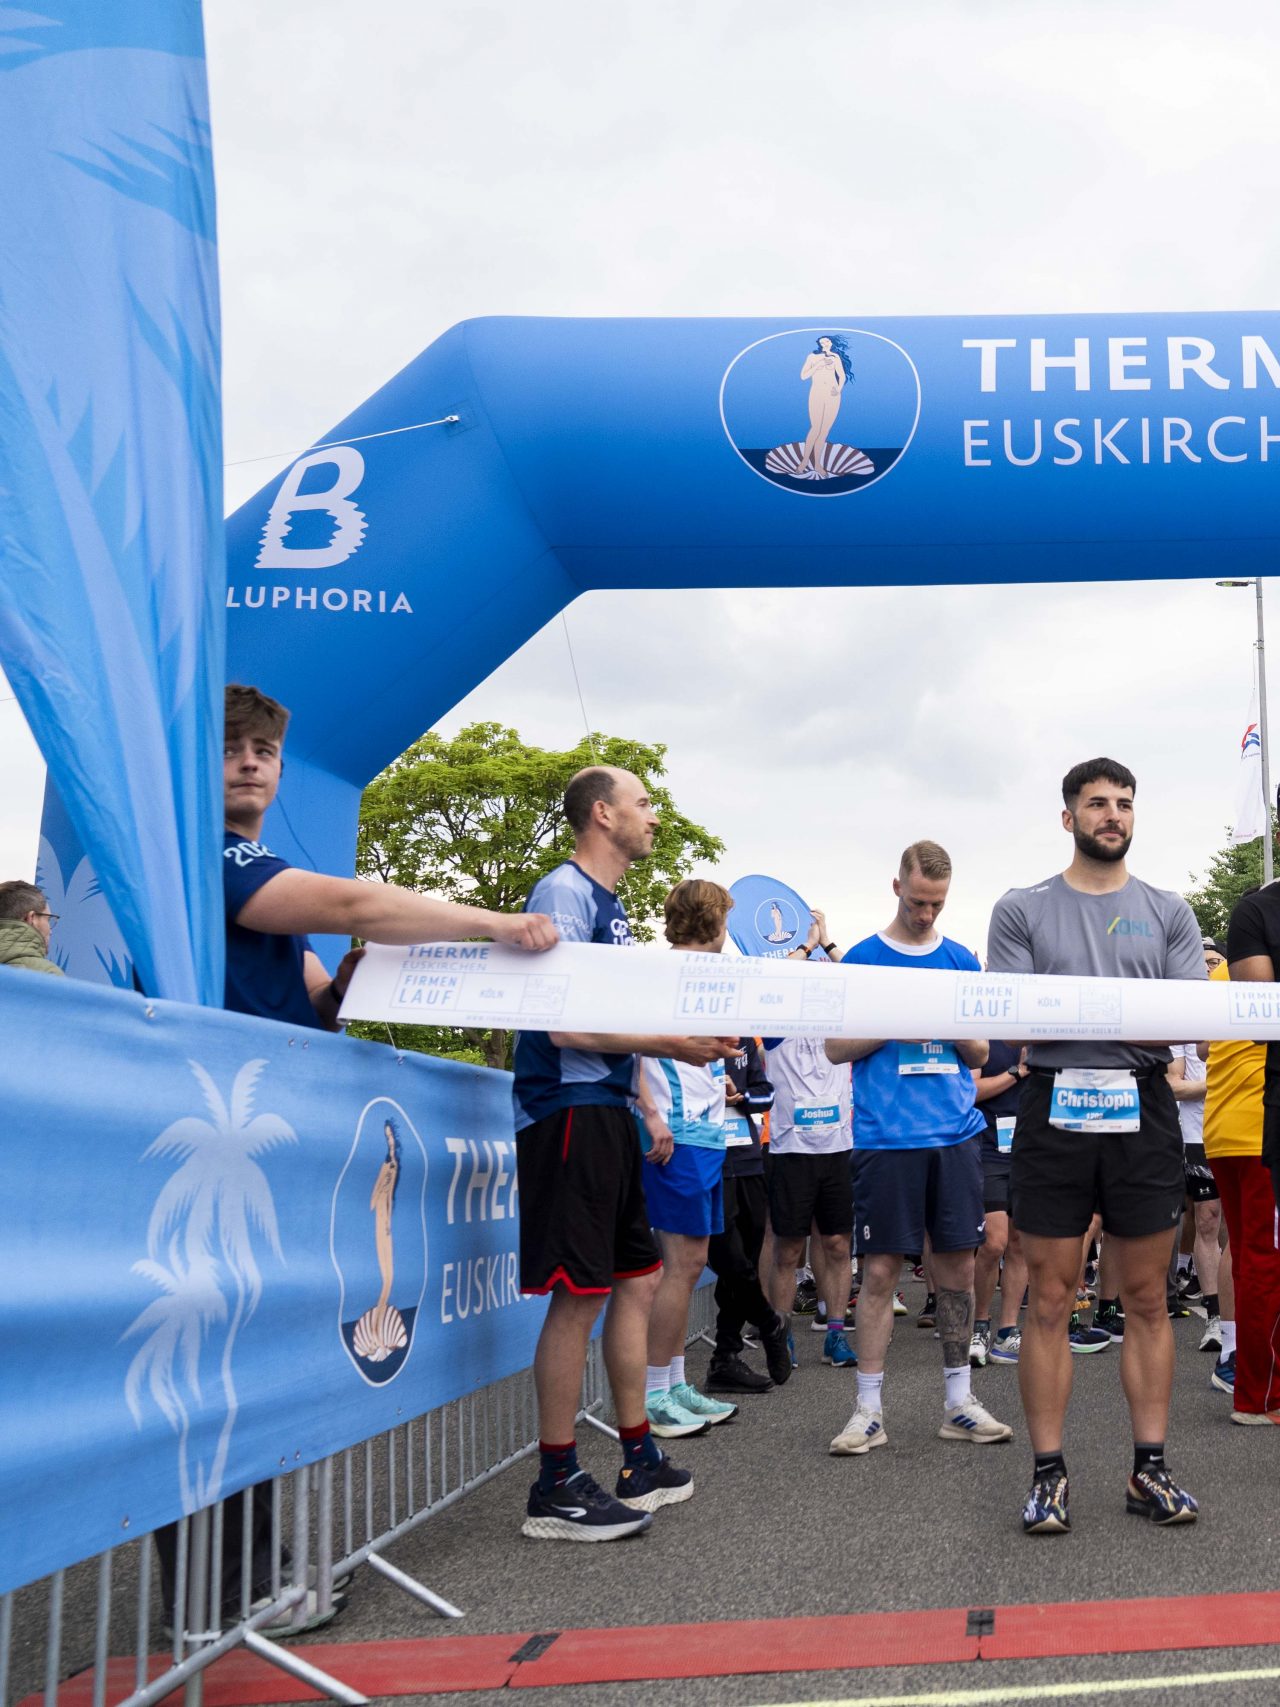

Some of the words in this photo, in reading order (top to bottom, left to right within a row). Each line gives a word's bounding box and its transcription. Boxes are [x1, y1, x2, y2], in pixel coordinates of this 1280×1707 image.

[254, 446, 369, 568] B
[226, 586, 414, 613] LUPHORIA
[408, 946, 490, 960] THERME
[762, 946, 799, 958] THER
[405, 974, 457, 987] FIRMEN
[685, 981, 735, 993] FIRMEN
[398, 988, 455, 1005] LAUF
[962, 985, 1012, 997] FIRMEN
[682, 997, 734, 1014] LAUF
[962, 1000, 1011, 1016] LAUF
[1037, 996, 1061, 1007] KÖLN
[921, 1042, 944, 1055] Tim
[1057, 1089, 1135, 1111] Christoph
[801, 1109, 834, 1120] Joshua
[445, 1137, 518, 1224] THE
[863, 1225, 871, 1240] 8
[441, 1252, 520, 1323] EUSKIR
